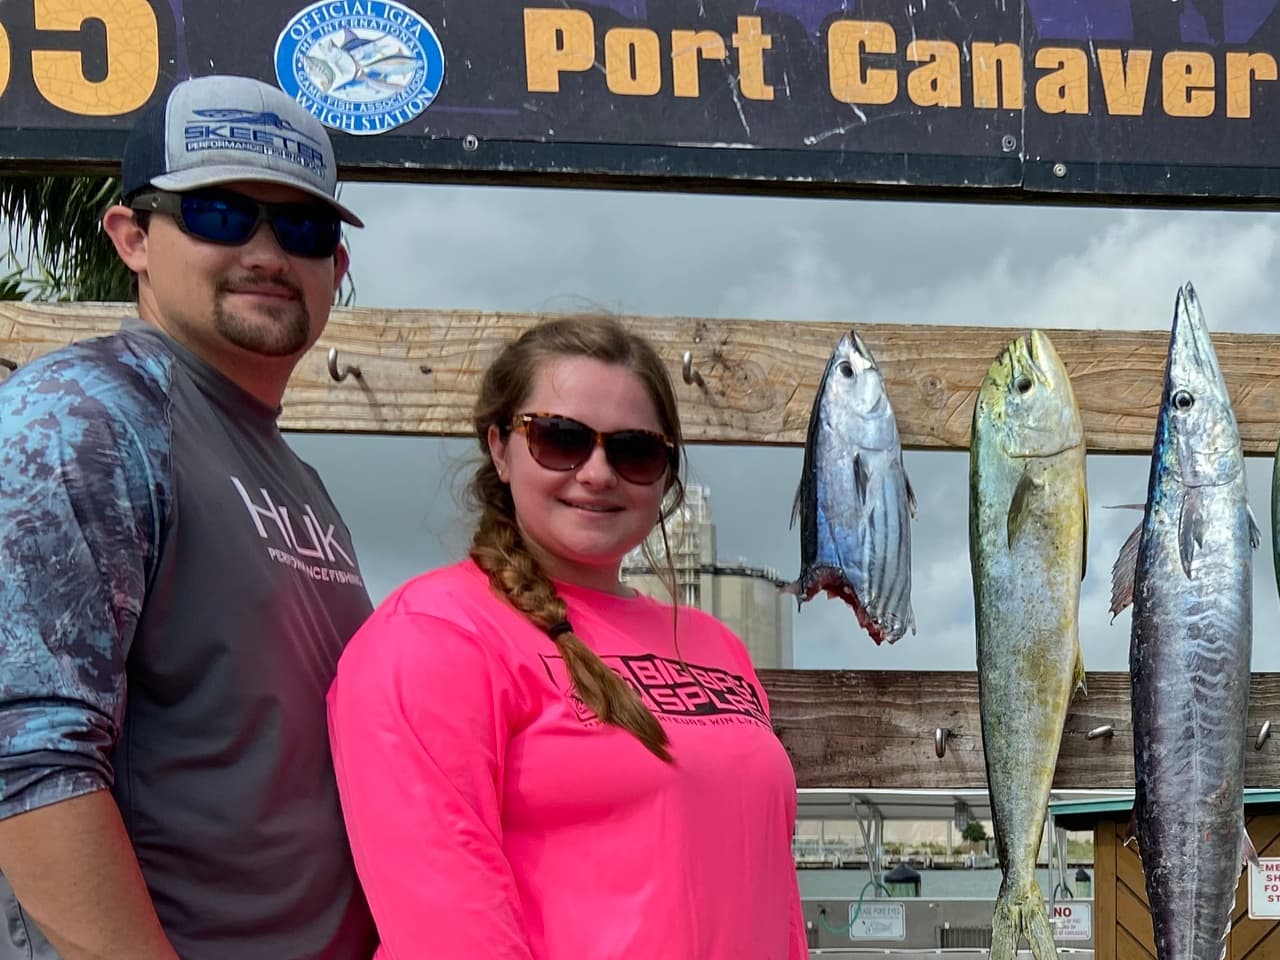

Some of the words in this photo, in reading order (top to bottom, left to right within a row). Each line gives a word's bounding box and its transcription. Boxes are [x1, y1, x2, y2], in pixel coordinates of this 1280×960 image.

[290, 1, 376, 41] OFFICIAL
[384, 4, 422, 38] IGFA
[319, 18, 419, 54] INTERNATIONAL
[0, 0, 159, 116] 5
[523, 7, 775, 101] Port
[295, 89, 355, 130] WEIGH
[362, 86, 434, 131] STATION
[326, 95, 355, 112] FISH
[359, 70, 424, 112] ASSOCIATION
[184, 124, 324, 167] SKEETER
[627, 657, 693, 686] BIG
[1053, 907, 1072, 918] NO
